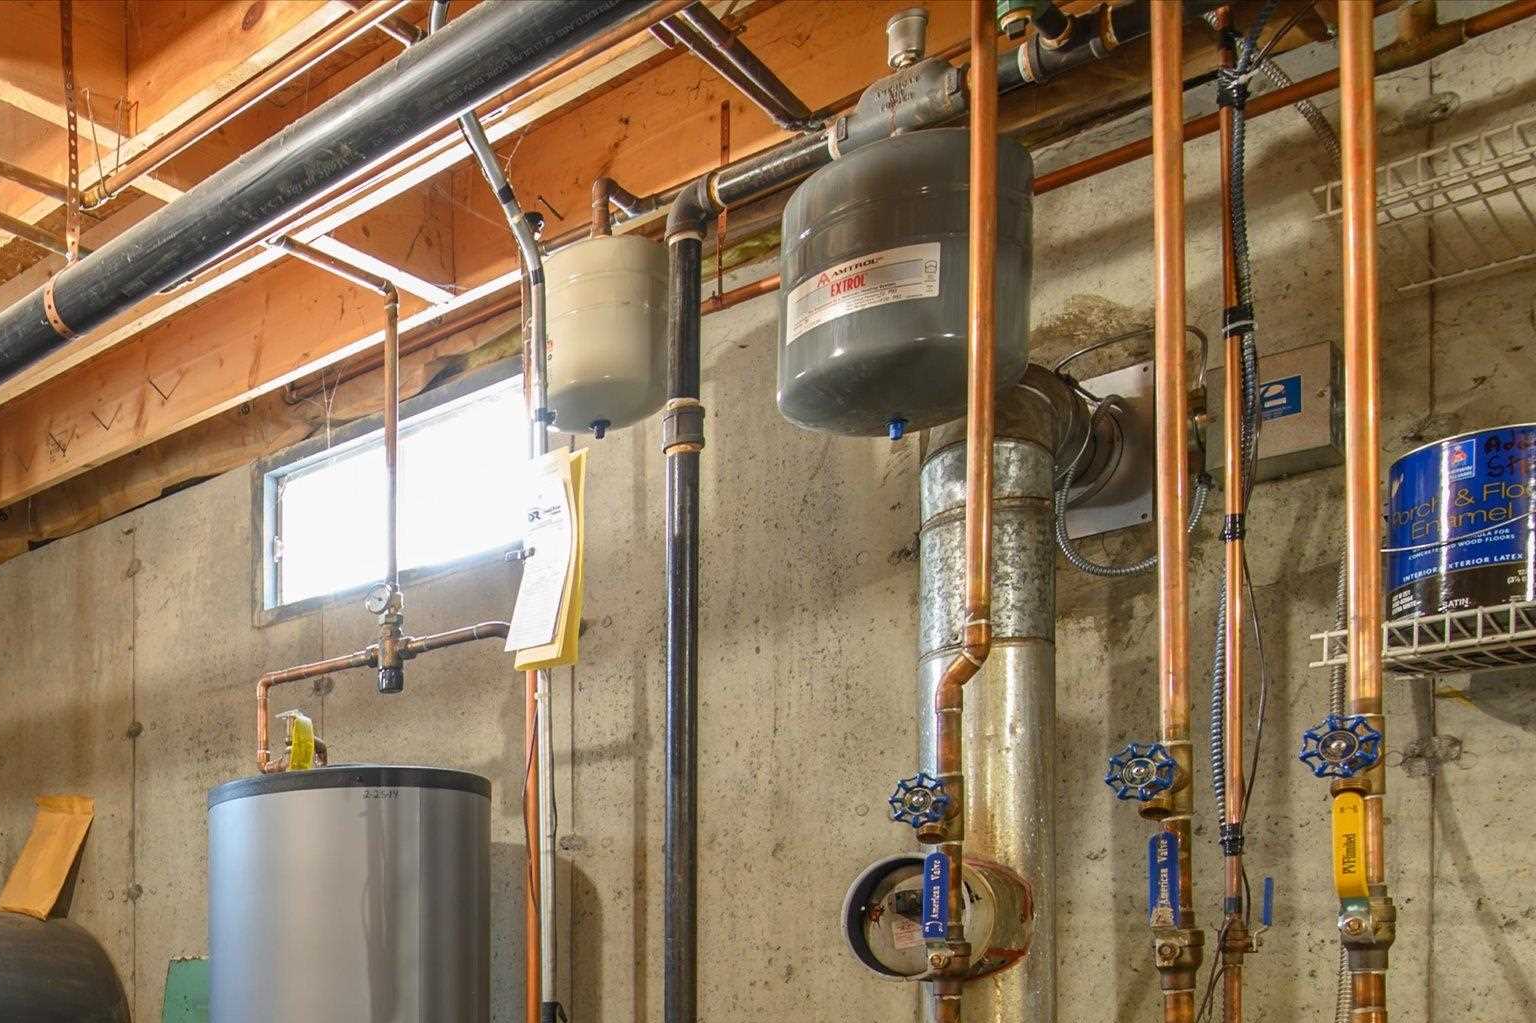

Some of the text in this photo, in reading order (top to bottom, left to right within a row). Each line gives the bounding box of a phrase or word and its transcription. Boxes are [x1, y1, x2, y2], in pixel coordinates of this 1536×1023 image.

[830, 273, 868, 298] EXTROL
[1454, 488, 1474, 508] &
[1411, 502, 1513, 541] Enamel
[1458, 537, 1483, 547] WOOD
[1485, 533, 1516, 543] FLOORS
[1493, 528, 1511, 536] FOR
[1493, 553, 1524, 563] LATEX
[930, 859, 942, 919] American Valve
